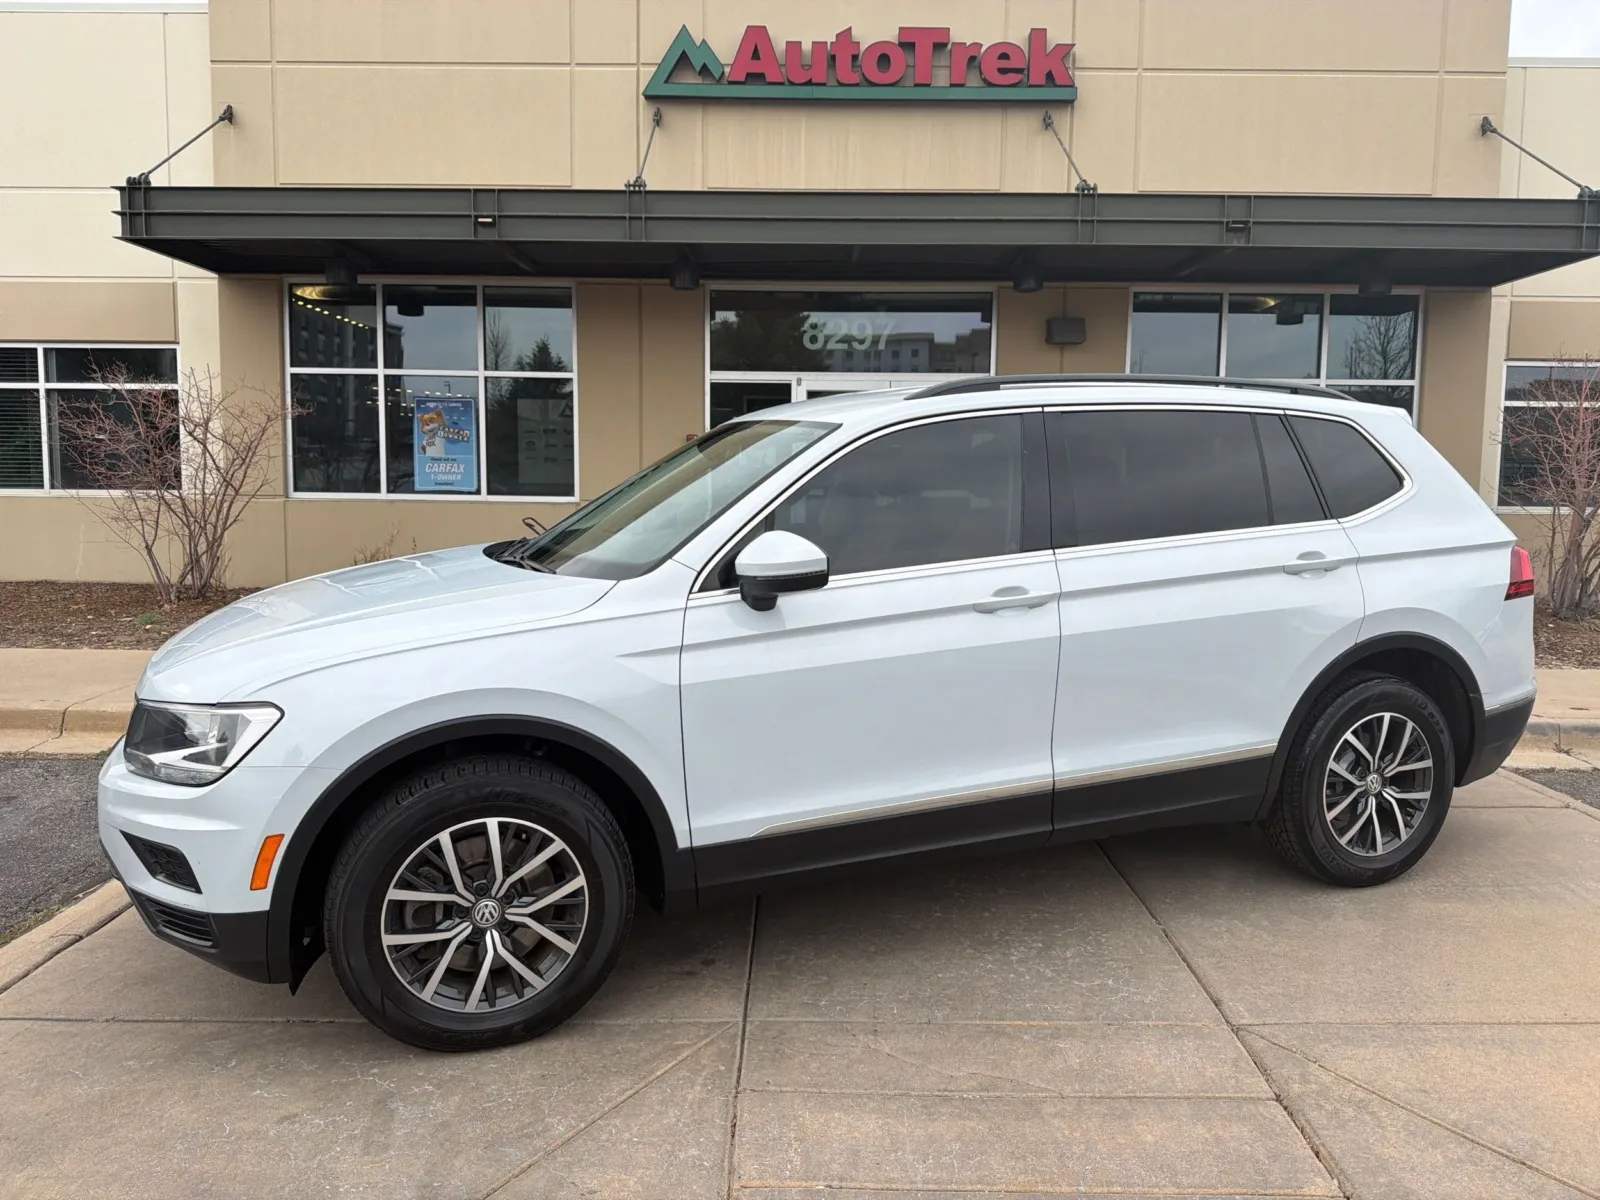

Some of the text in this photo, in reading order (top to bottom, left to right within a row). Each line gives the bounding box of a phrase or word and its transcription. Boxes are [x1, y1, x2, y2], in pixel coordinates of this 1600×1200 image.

[727, 25, 1077, 87] AutoTrek
[802, 318, 897, 350] 8297
[425, 463, 465, 473] CARFAX
